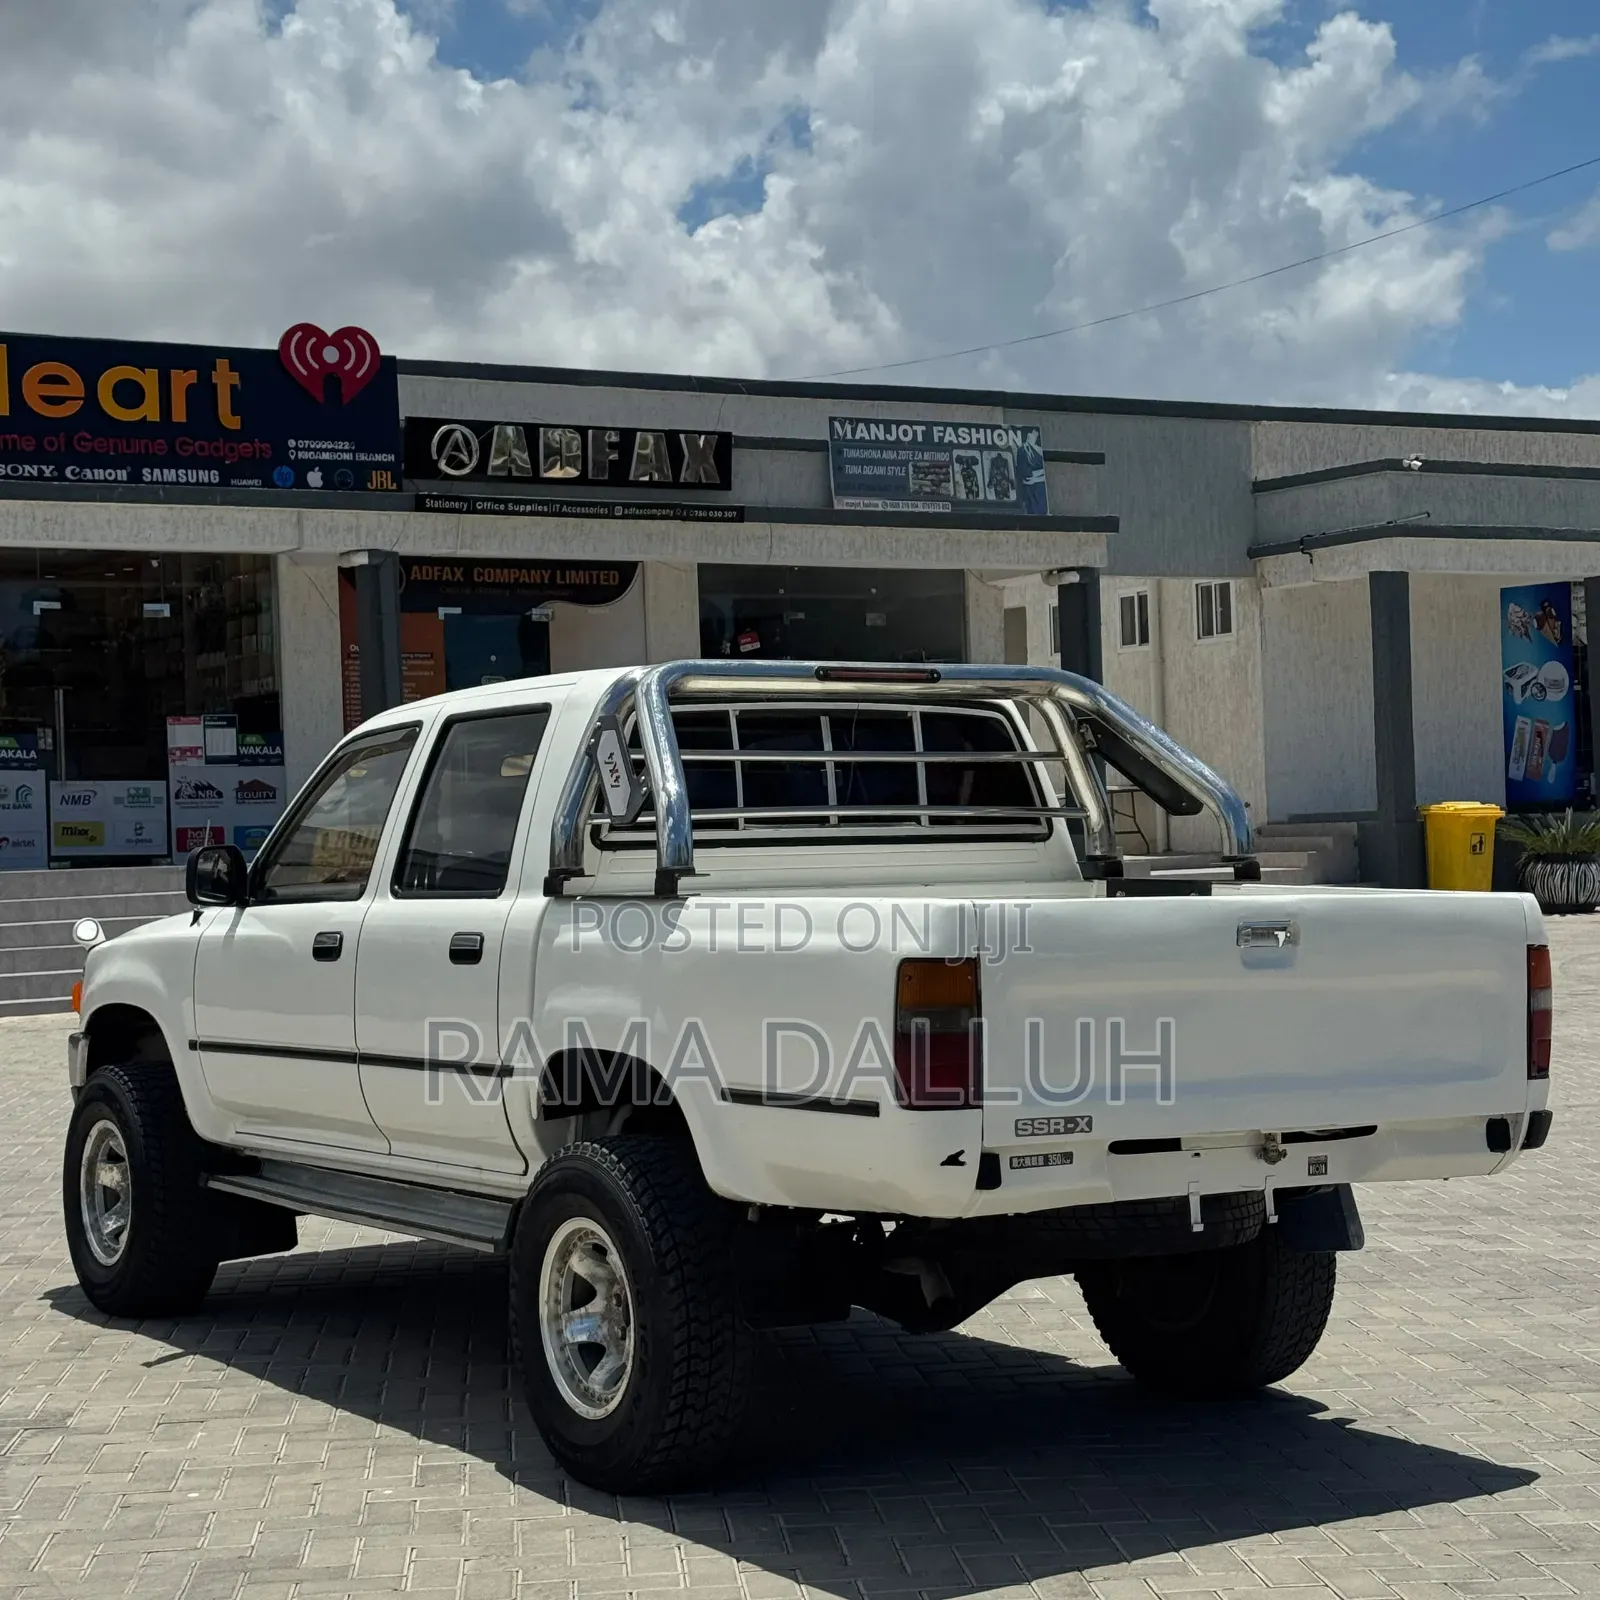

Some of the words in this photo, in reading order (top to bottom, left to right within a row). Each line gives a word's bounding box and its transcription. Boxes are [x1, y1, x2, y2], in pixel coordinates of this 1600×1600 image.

[833, 418, 926, 442] MANJOT
[933, 425, 1022, 447] FASHION
[43, 432, 66, 453] of
[73, 431, 168, 457] Genuine
[175, 436, 272, 463] Gadgets
[486, 425, 721, 484] ADFAX
[355, 452, 395, 462] BRANCH
[65, 465, 128, 481] Canon
[142, 467, 219, 484] SAMSUNG
[367, 469, 397, 490] JBL
[231, 477, 262, 487] HUAWEI
[425, 498, 468, 511] Stationery
[476, 500, 505, 511] Office
[508, 501, 548, 513] Supplies
[562, 504, 609, 515] Accessories
[410, 564, 464, 583] ADFAX
[473, 566, 552, 584] COMPANY
[556, 569, 619, 586] LIMITED
[239, 745, 282, 755] WAKALA
[60, 794, 92, 806] NMB
[237, 791, 275, 799] EQUITY
[1017, 1116, 1090, 1135] SSR-X
[1047, 1153, 1061, 1166] 350
